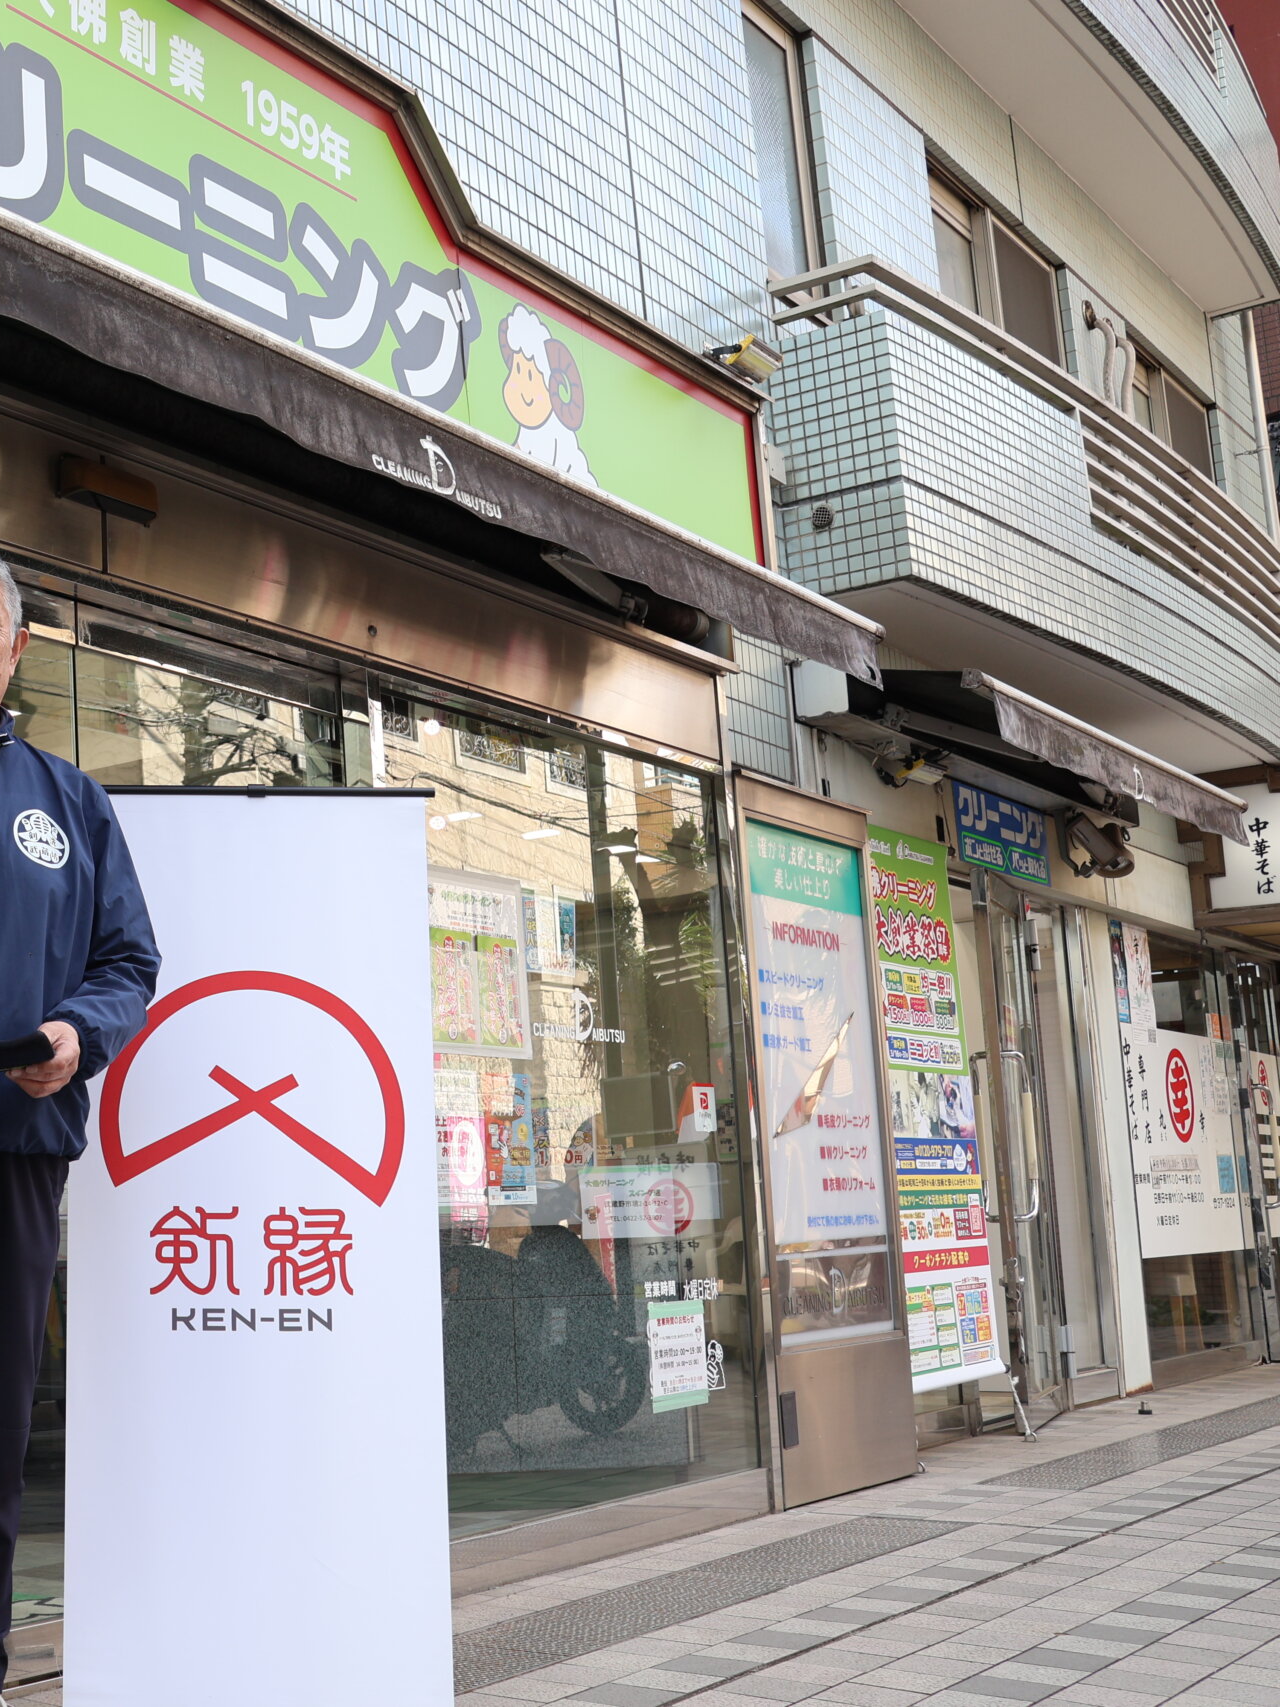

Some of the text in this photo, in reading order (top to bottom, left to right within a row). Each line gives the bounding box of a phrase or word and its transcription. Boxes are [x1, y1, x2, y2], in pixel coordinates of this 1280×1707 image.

[36, 0, 352, 181] 佛創業 1959年
[371, 435, 502, 519] CLEANING DAIBUTSU
[958, 786, 1044, 849] クリーニング
[1247, 816, 1275, 896] 中華そば
[771, 920, 840, 952] INFORMATION
[764, 969, 825, 991] スピードクリーニング
[532, 988, 626, 1044] CLEANING DAIBUTSU
[1122, 1036, 1140, 1141] 中華そば
[1138, 1053, 1152, 1144] 専門店
[823, 1114, 871, 1129] 毛皮クリーニング
[826, 1146, 868, 1160] Wクリーニング
[828, 1177, 876, 1192] 衣類のリフォーム
[913, 1250, 970, 1270] クーポンチラシ配布中
[644, 1277, 718, 1300] 営業時間 水曜日定休
[783, 1291, 832, 1317] CLEANING
[171, 1307, 333, 1332] KEN-EN
